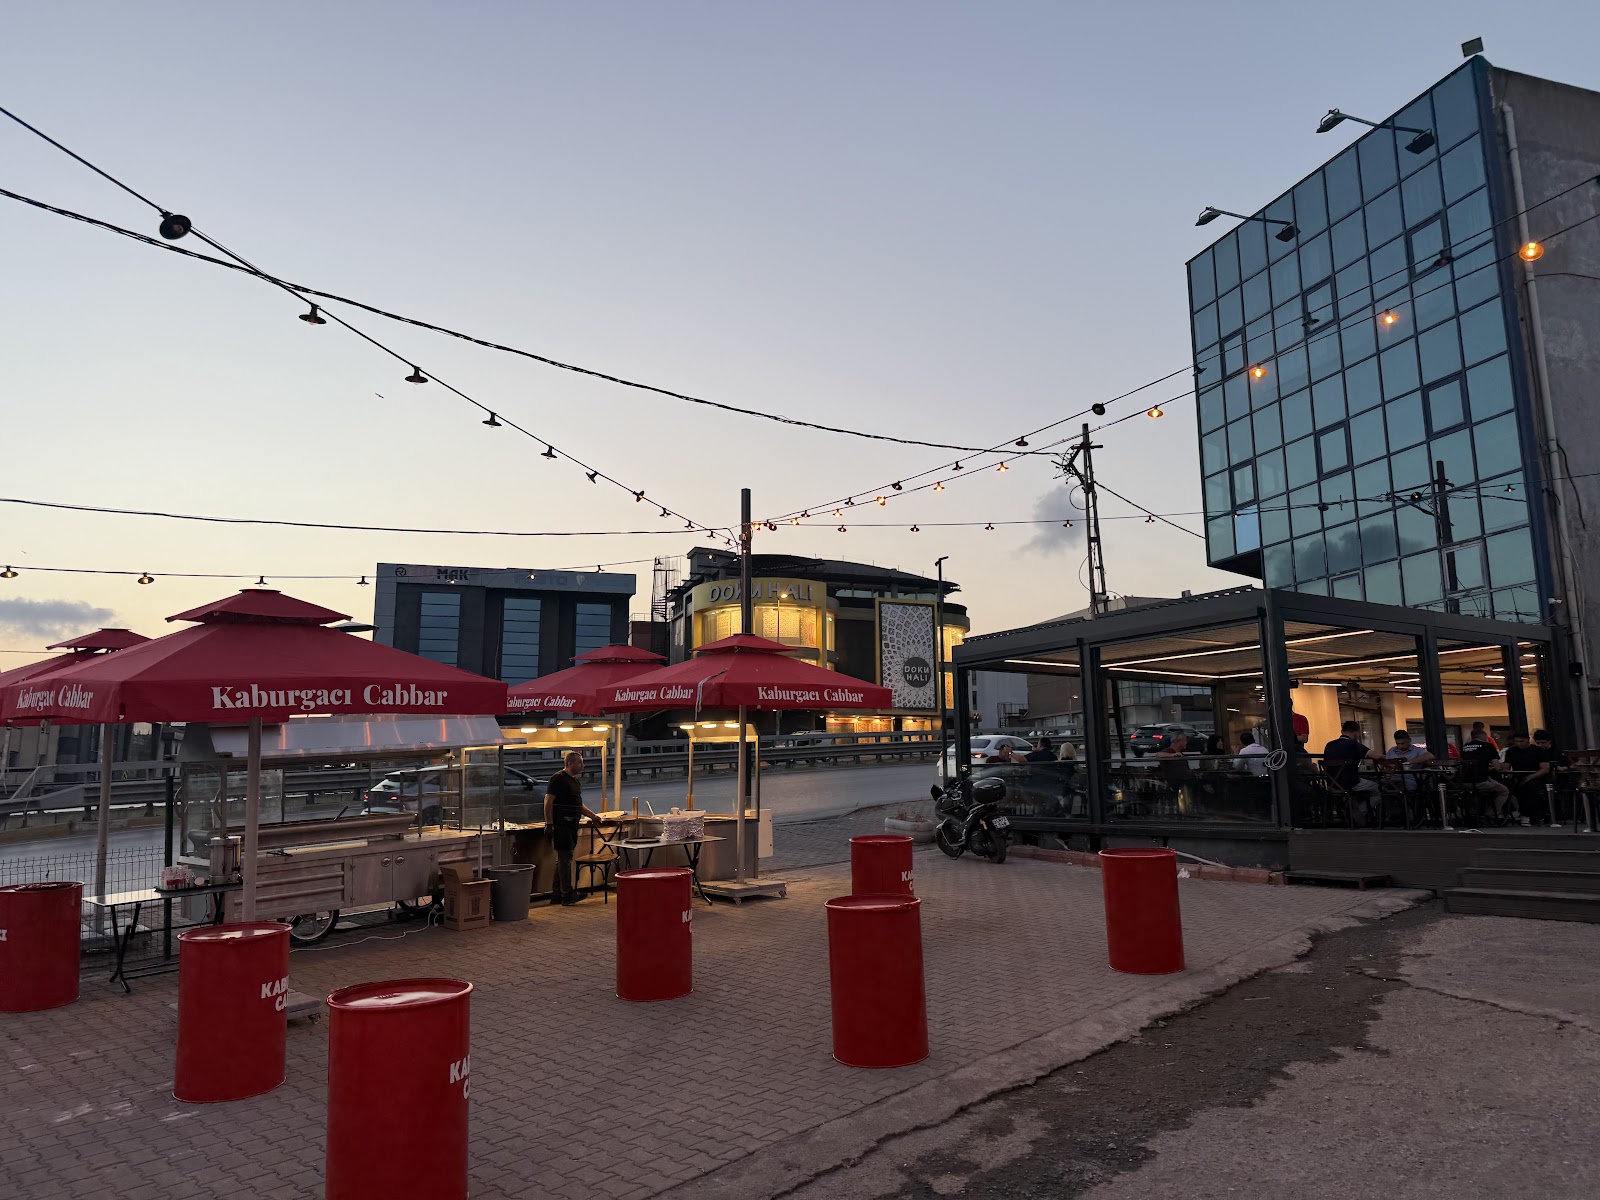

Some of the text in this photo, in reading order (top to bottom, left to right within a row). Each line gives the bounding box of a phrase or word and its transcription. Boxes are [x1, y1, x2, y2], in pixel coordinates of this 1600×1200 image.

[58, 684, 94, 708] Cabbar
[211, 684, 448, 710] Kaburgacı Cabbar
[660, 685, 694, 699] Cabbar
[757, 686, 864, 703] Kaburgacı Cabbar
[543, 695, 576, 708] Cabbar
